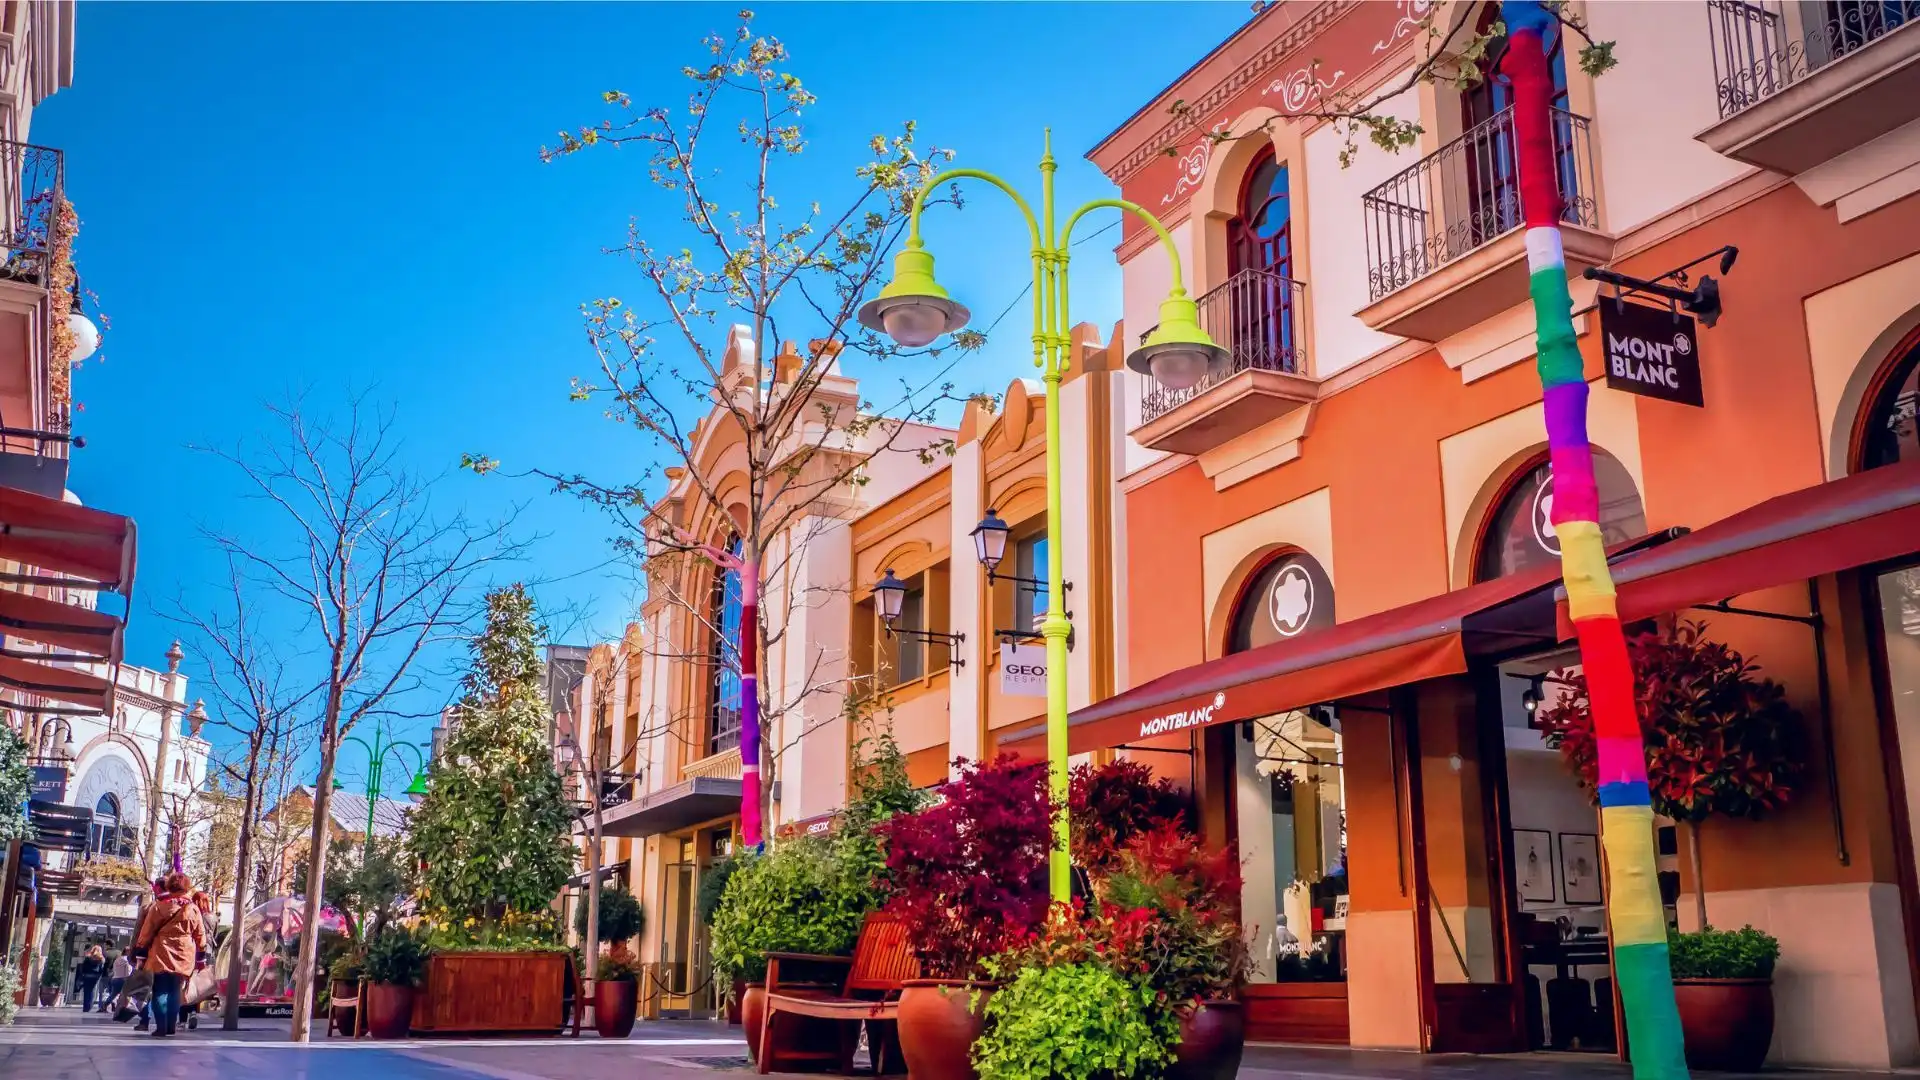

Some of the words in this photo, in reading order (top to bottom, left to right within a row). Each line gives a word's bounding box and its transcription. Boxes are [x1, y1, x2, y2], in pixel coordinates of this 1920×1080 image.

[1608, 332, 1675, 366] MONT
[1611, 354, 1680, 389] BLANC
[1005, 663, 1048, 677] GEO
[1140, 705, 1214, 737] MONTBLANC
[265, 1007, 294, 1016] #LasRoz
